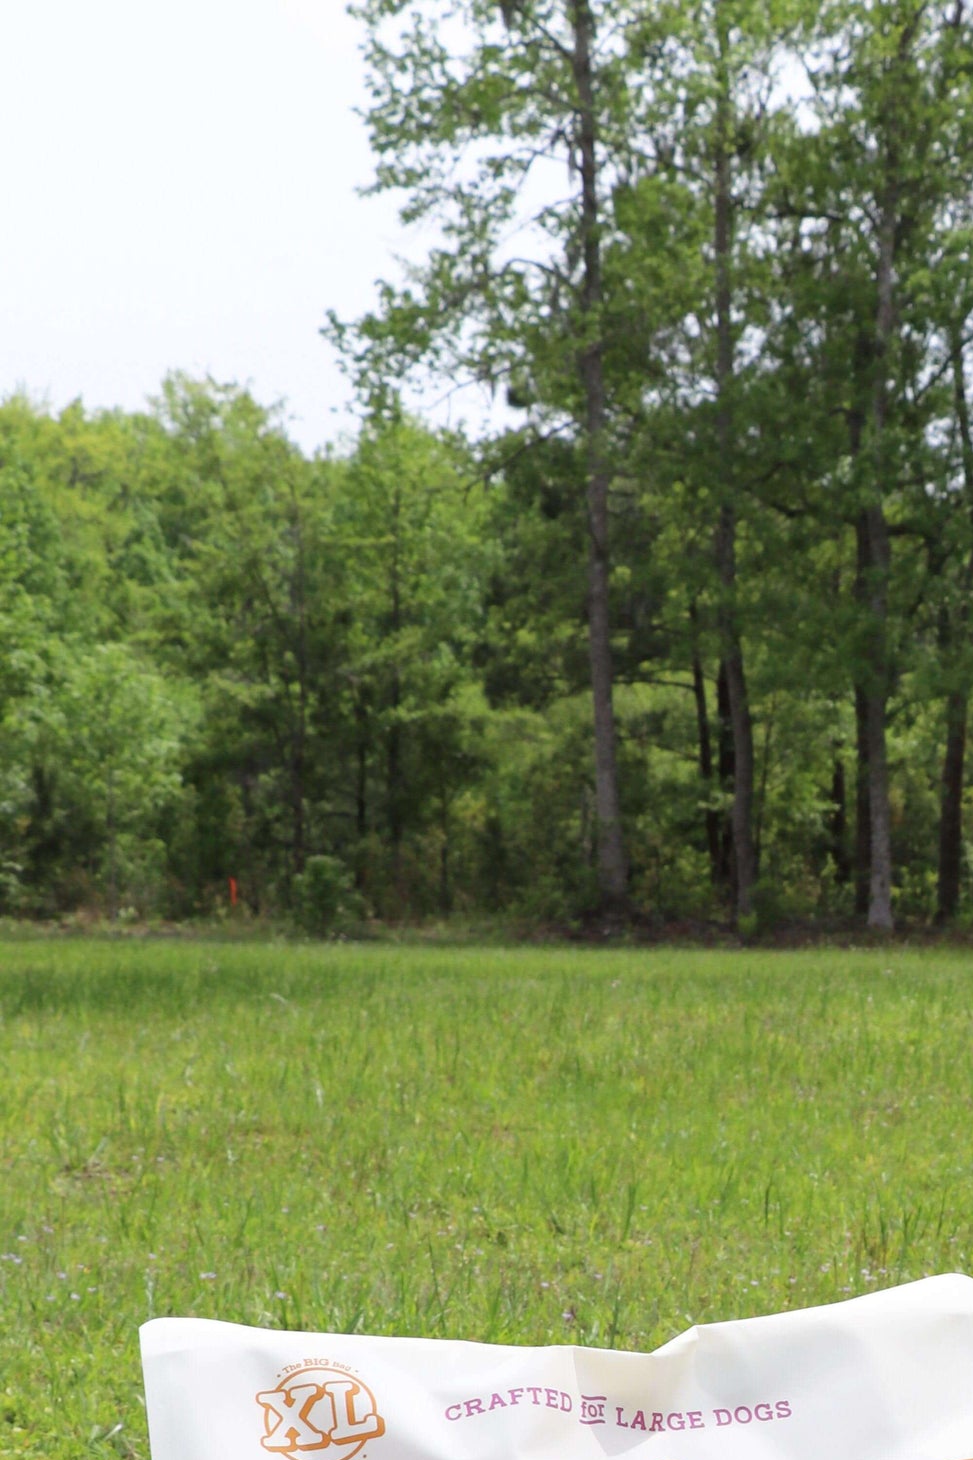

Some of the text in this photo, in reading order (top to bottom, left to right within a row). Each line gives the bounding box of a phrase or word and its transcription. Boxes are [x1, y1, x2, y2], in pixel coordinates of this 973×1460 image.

[282, 1363, 302, 1375] The
[303, 1358, 330, 1367] BIG
[255, 1380, 386, 1453] XL
[444, 1386, 793, 1432] CRAFTED for LARGE DOGS
